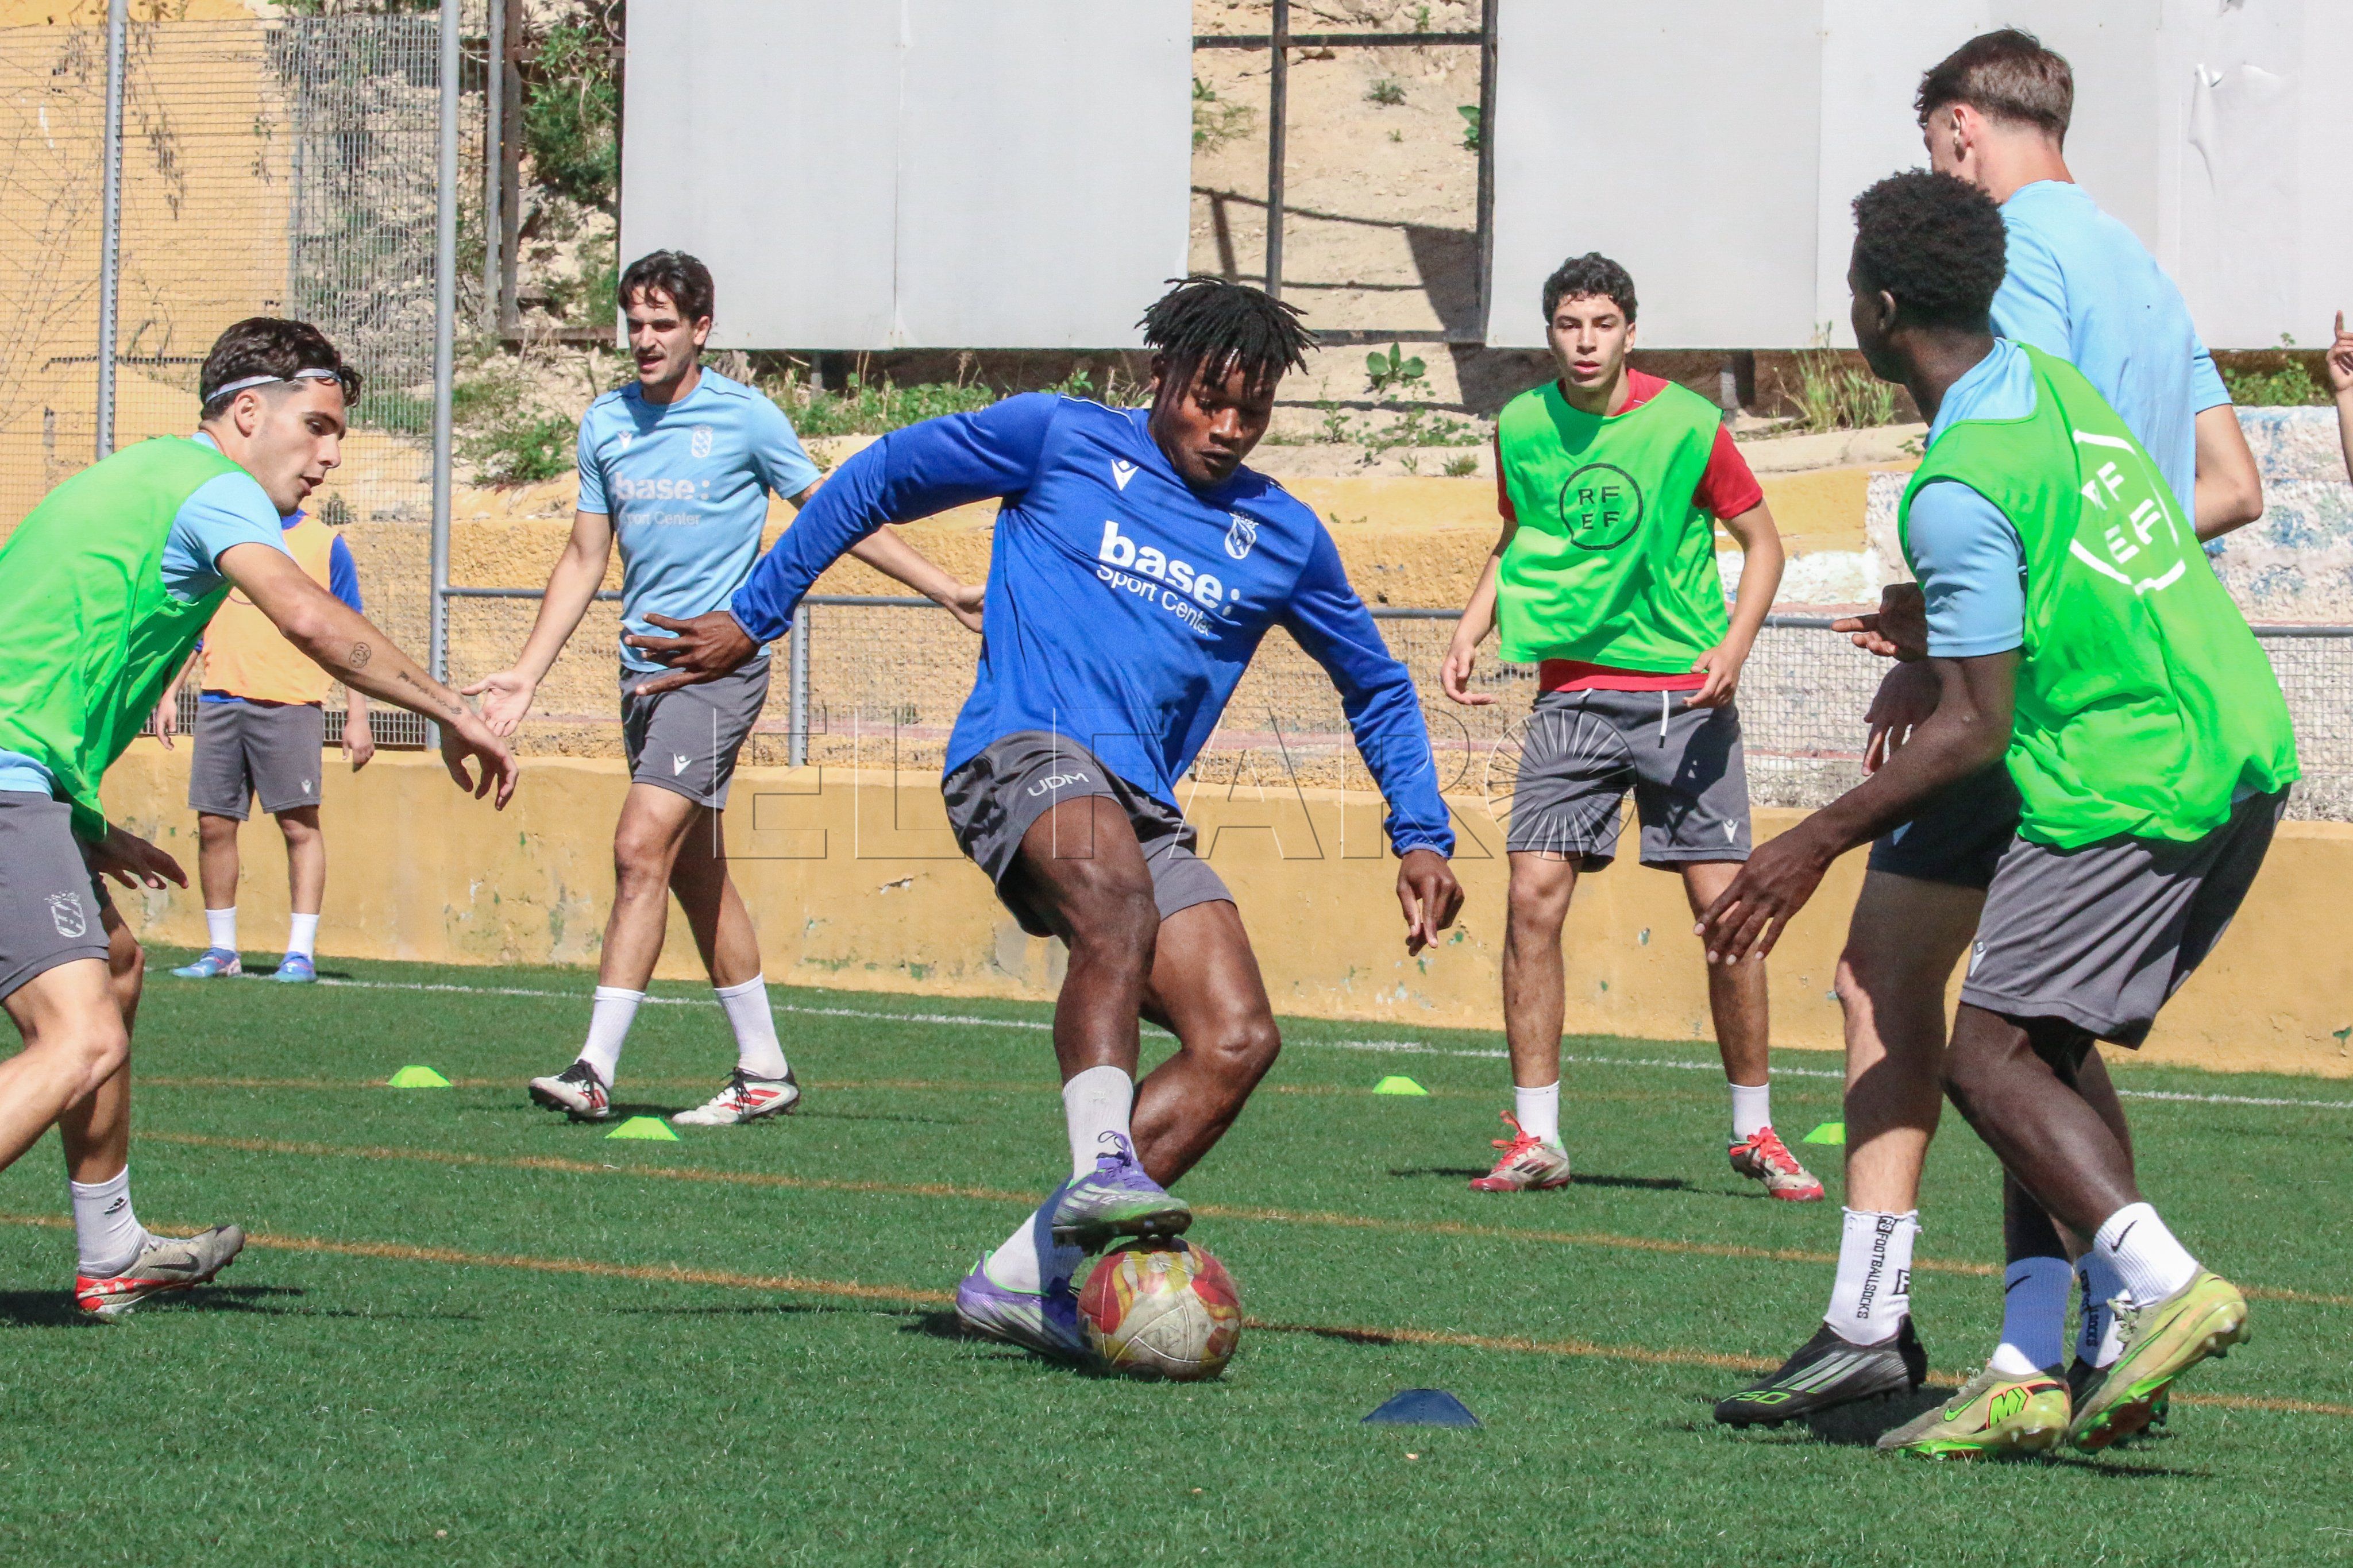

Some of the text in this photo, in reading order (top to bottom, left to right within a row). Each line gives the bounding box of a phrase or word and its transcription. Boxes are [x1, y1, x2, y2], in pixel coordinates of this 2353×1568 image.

[1096, 565, 1212, 636] Sport Center
[1027, 773, 1090, 797] UDM
[1857, 1233, 1888, 1319] FOOTBALLSOCKS
